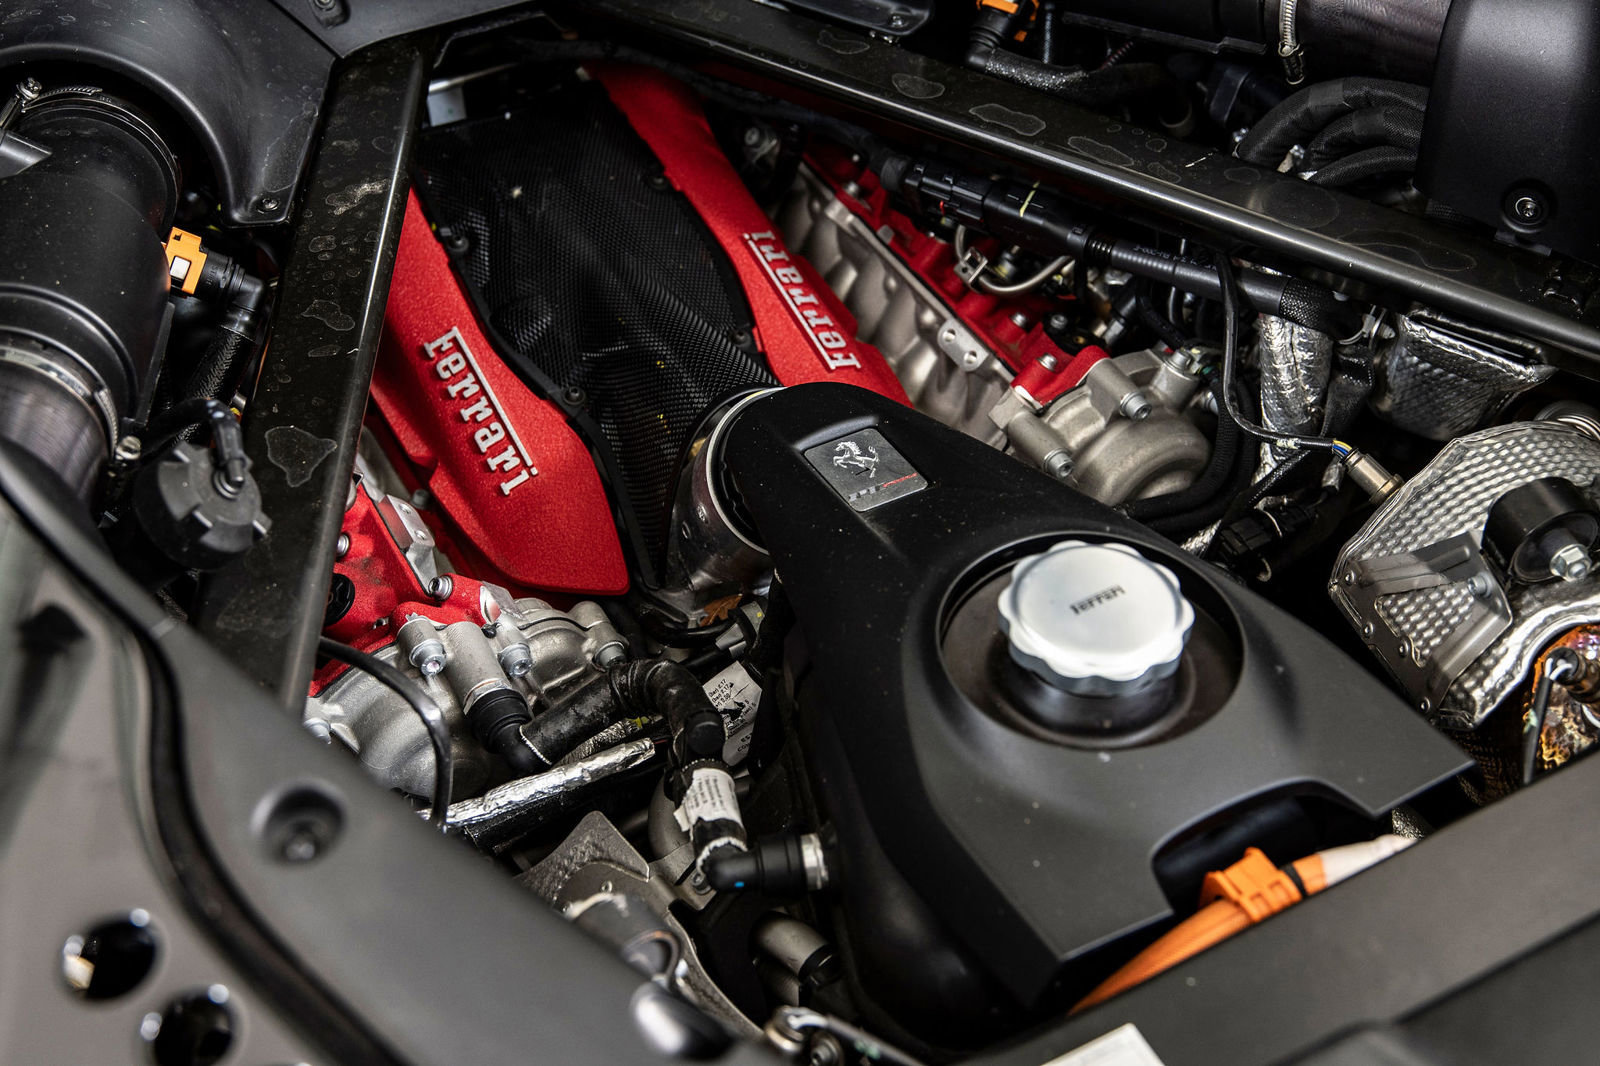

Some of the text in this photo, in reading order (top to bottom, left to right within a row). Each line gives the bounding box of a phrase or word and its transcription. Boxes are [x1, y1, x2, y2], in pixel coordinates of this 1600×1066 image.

[743, 230, 861, 370] Ferrari
[424, 326, 539, 496] Ferrari
[1069, 585, 1126, 615] Ferrari
